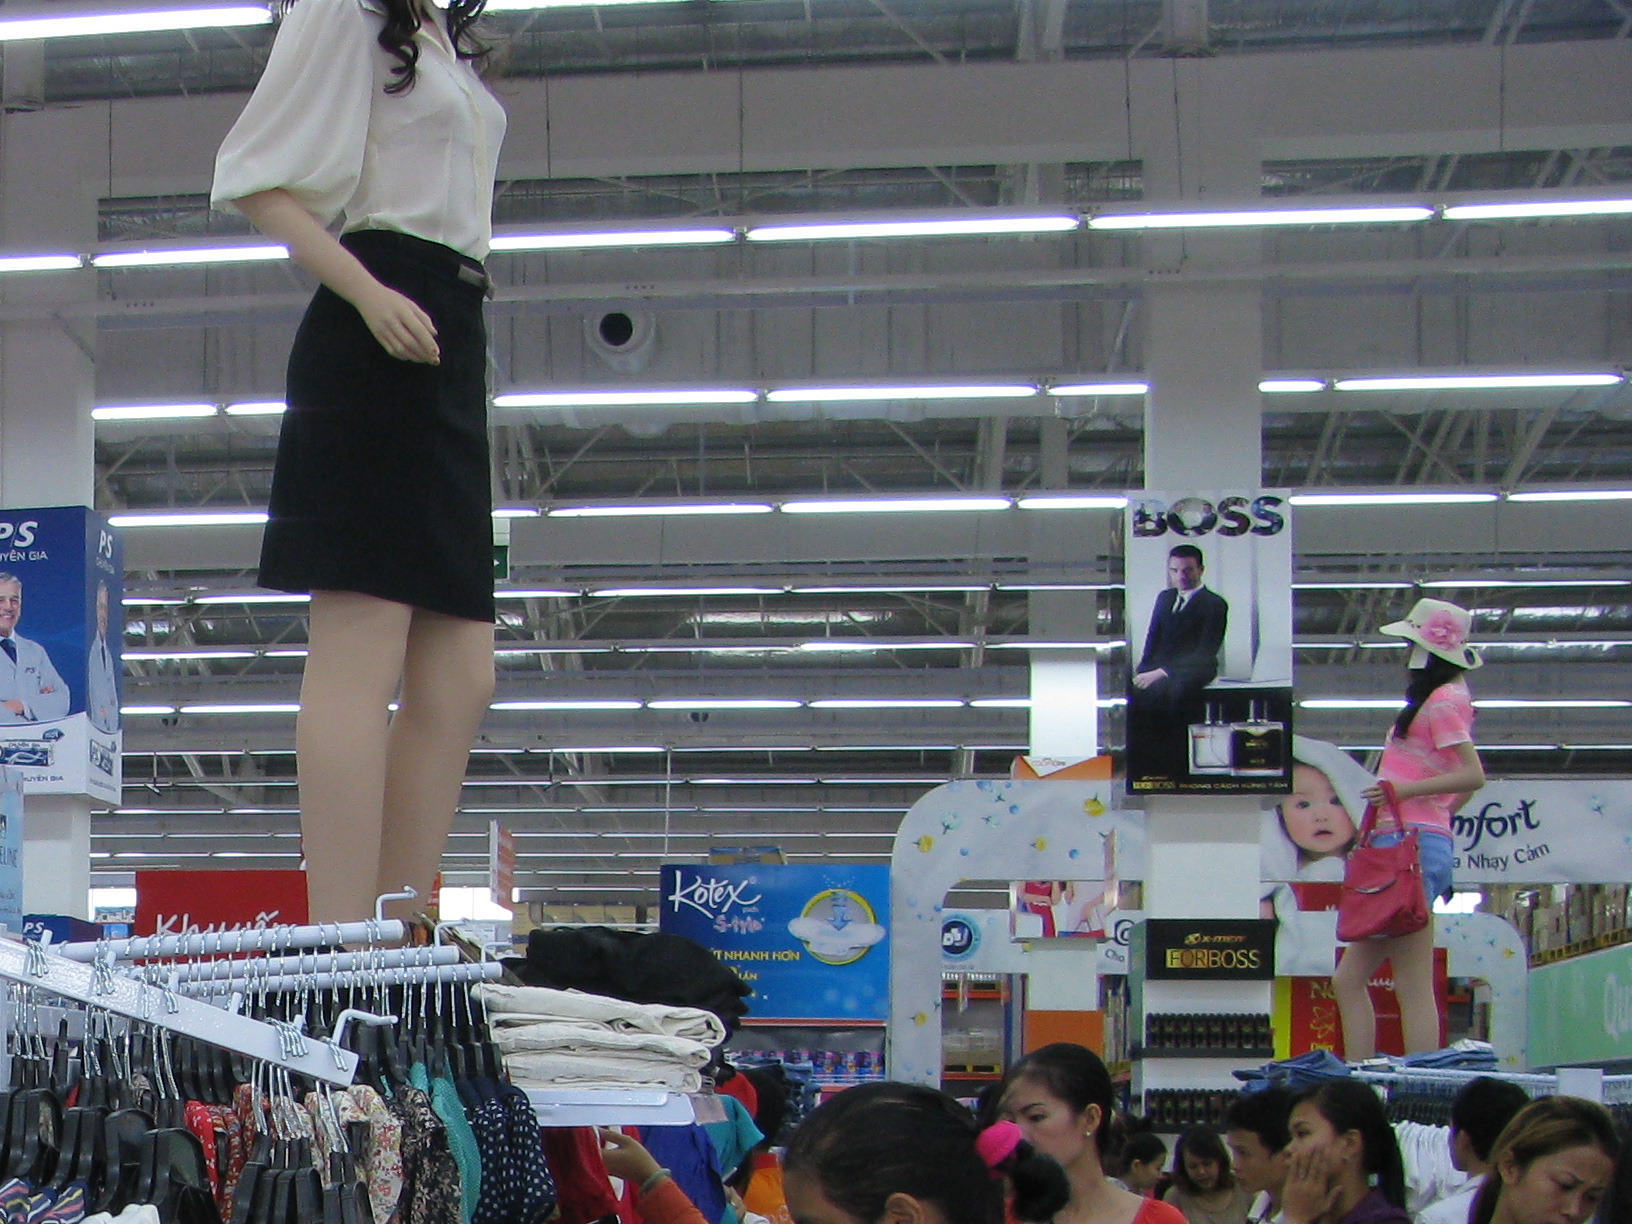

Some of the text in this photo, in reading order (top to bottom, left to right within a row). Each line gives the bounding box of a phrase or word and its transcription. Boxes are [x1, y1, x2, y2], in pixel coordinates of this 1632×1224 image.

[1133, 495, 1284, 537] BOSS
[29, 550, 49, 561] GIA
[1451, 799, 1540, 851] mfort
[1468, 854, 1509, 872] Nhạy
[1514, 842, 1550, 864] Cảm
[668, 870, 762, 919] Kotex
[725, 951, 769, 960] NHANH
